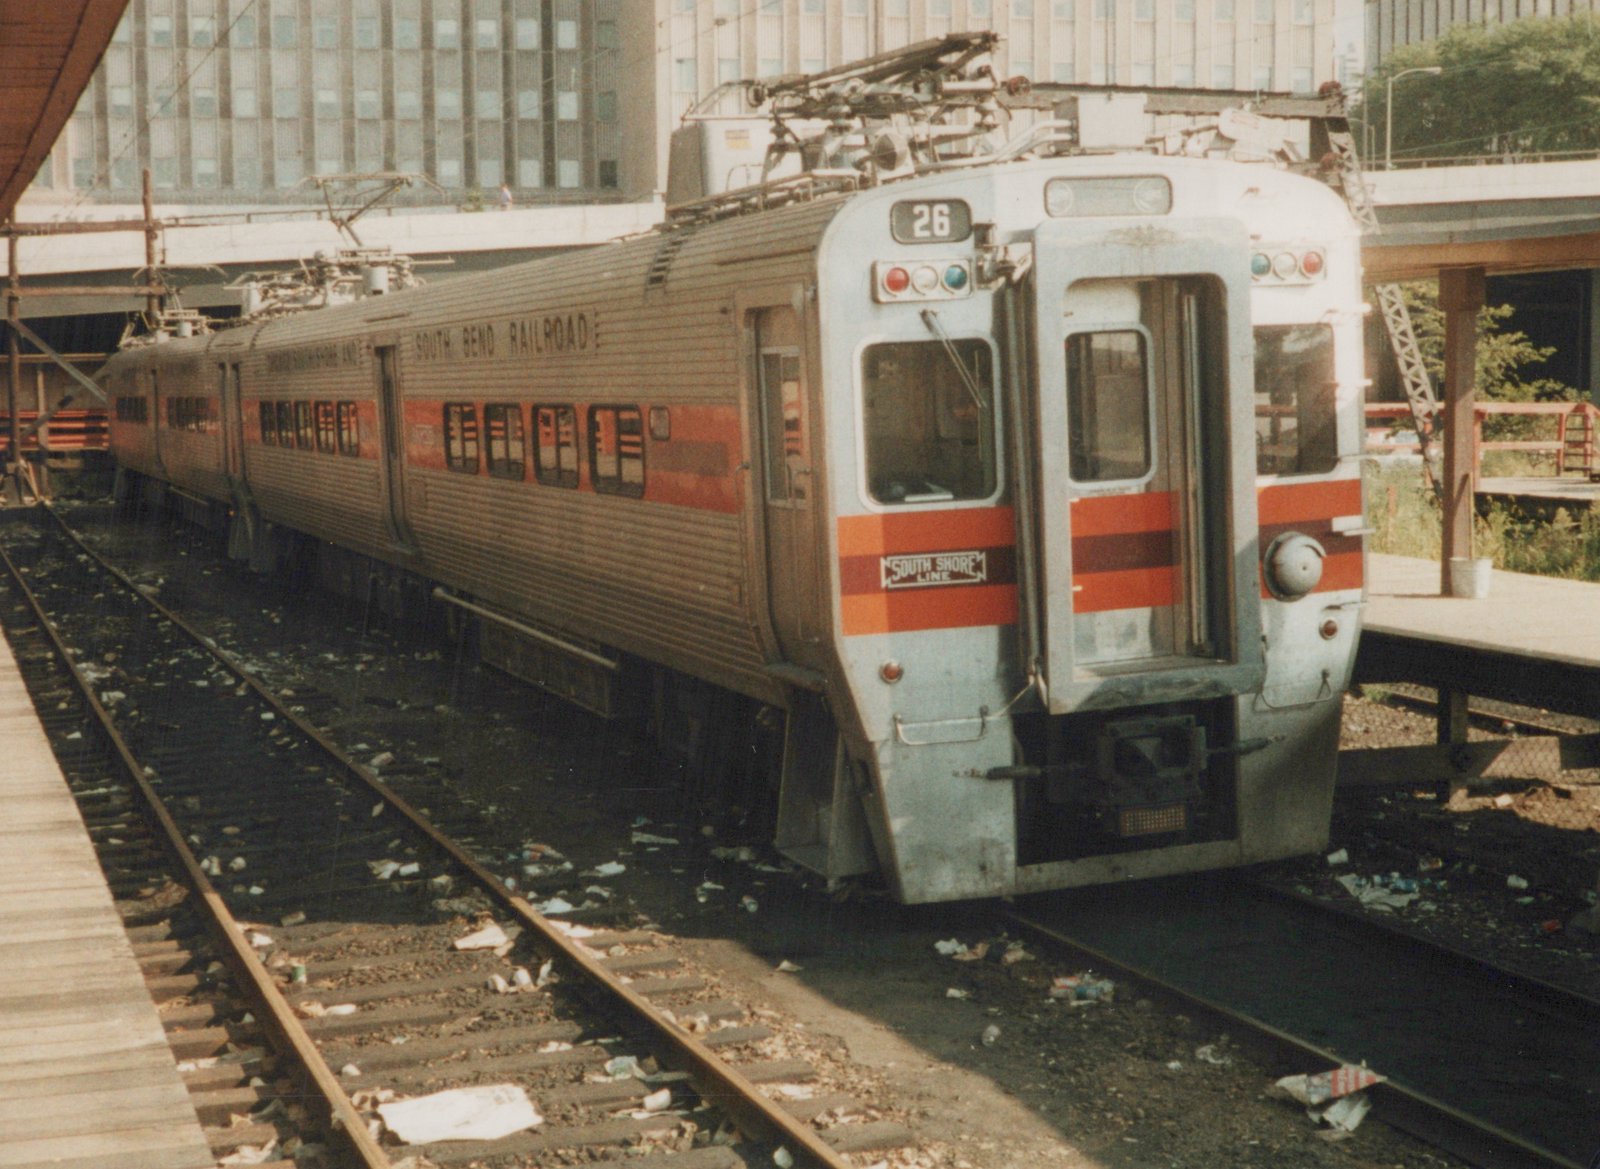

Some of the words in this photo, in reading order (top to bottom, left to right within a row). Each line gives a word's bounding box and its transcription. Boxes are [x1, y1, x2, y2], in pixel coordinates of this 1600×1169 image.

[913, 204, 950, 238] 26
[416, 329, 451, 361] SOUTH
[463, 324, 495, 359] BEND
[510, 312, 588, 355] RAILROAD
[892, 558, 931, 582] SOUTH
[936, 556, 978, 577] SHORE
[917, 572, 951, 582] LINE
